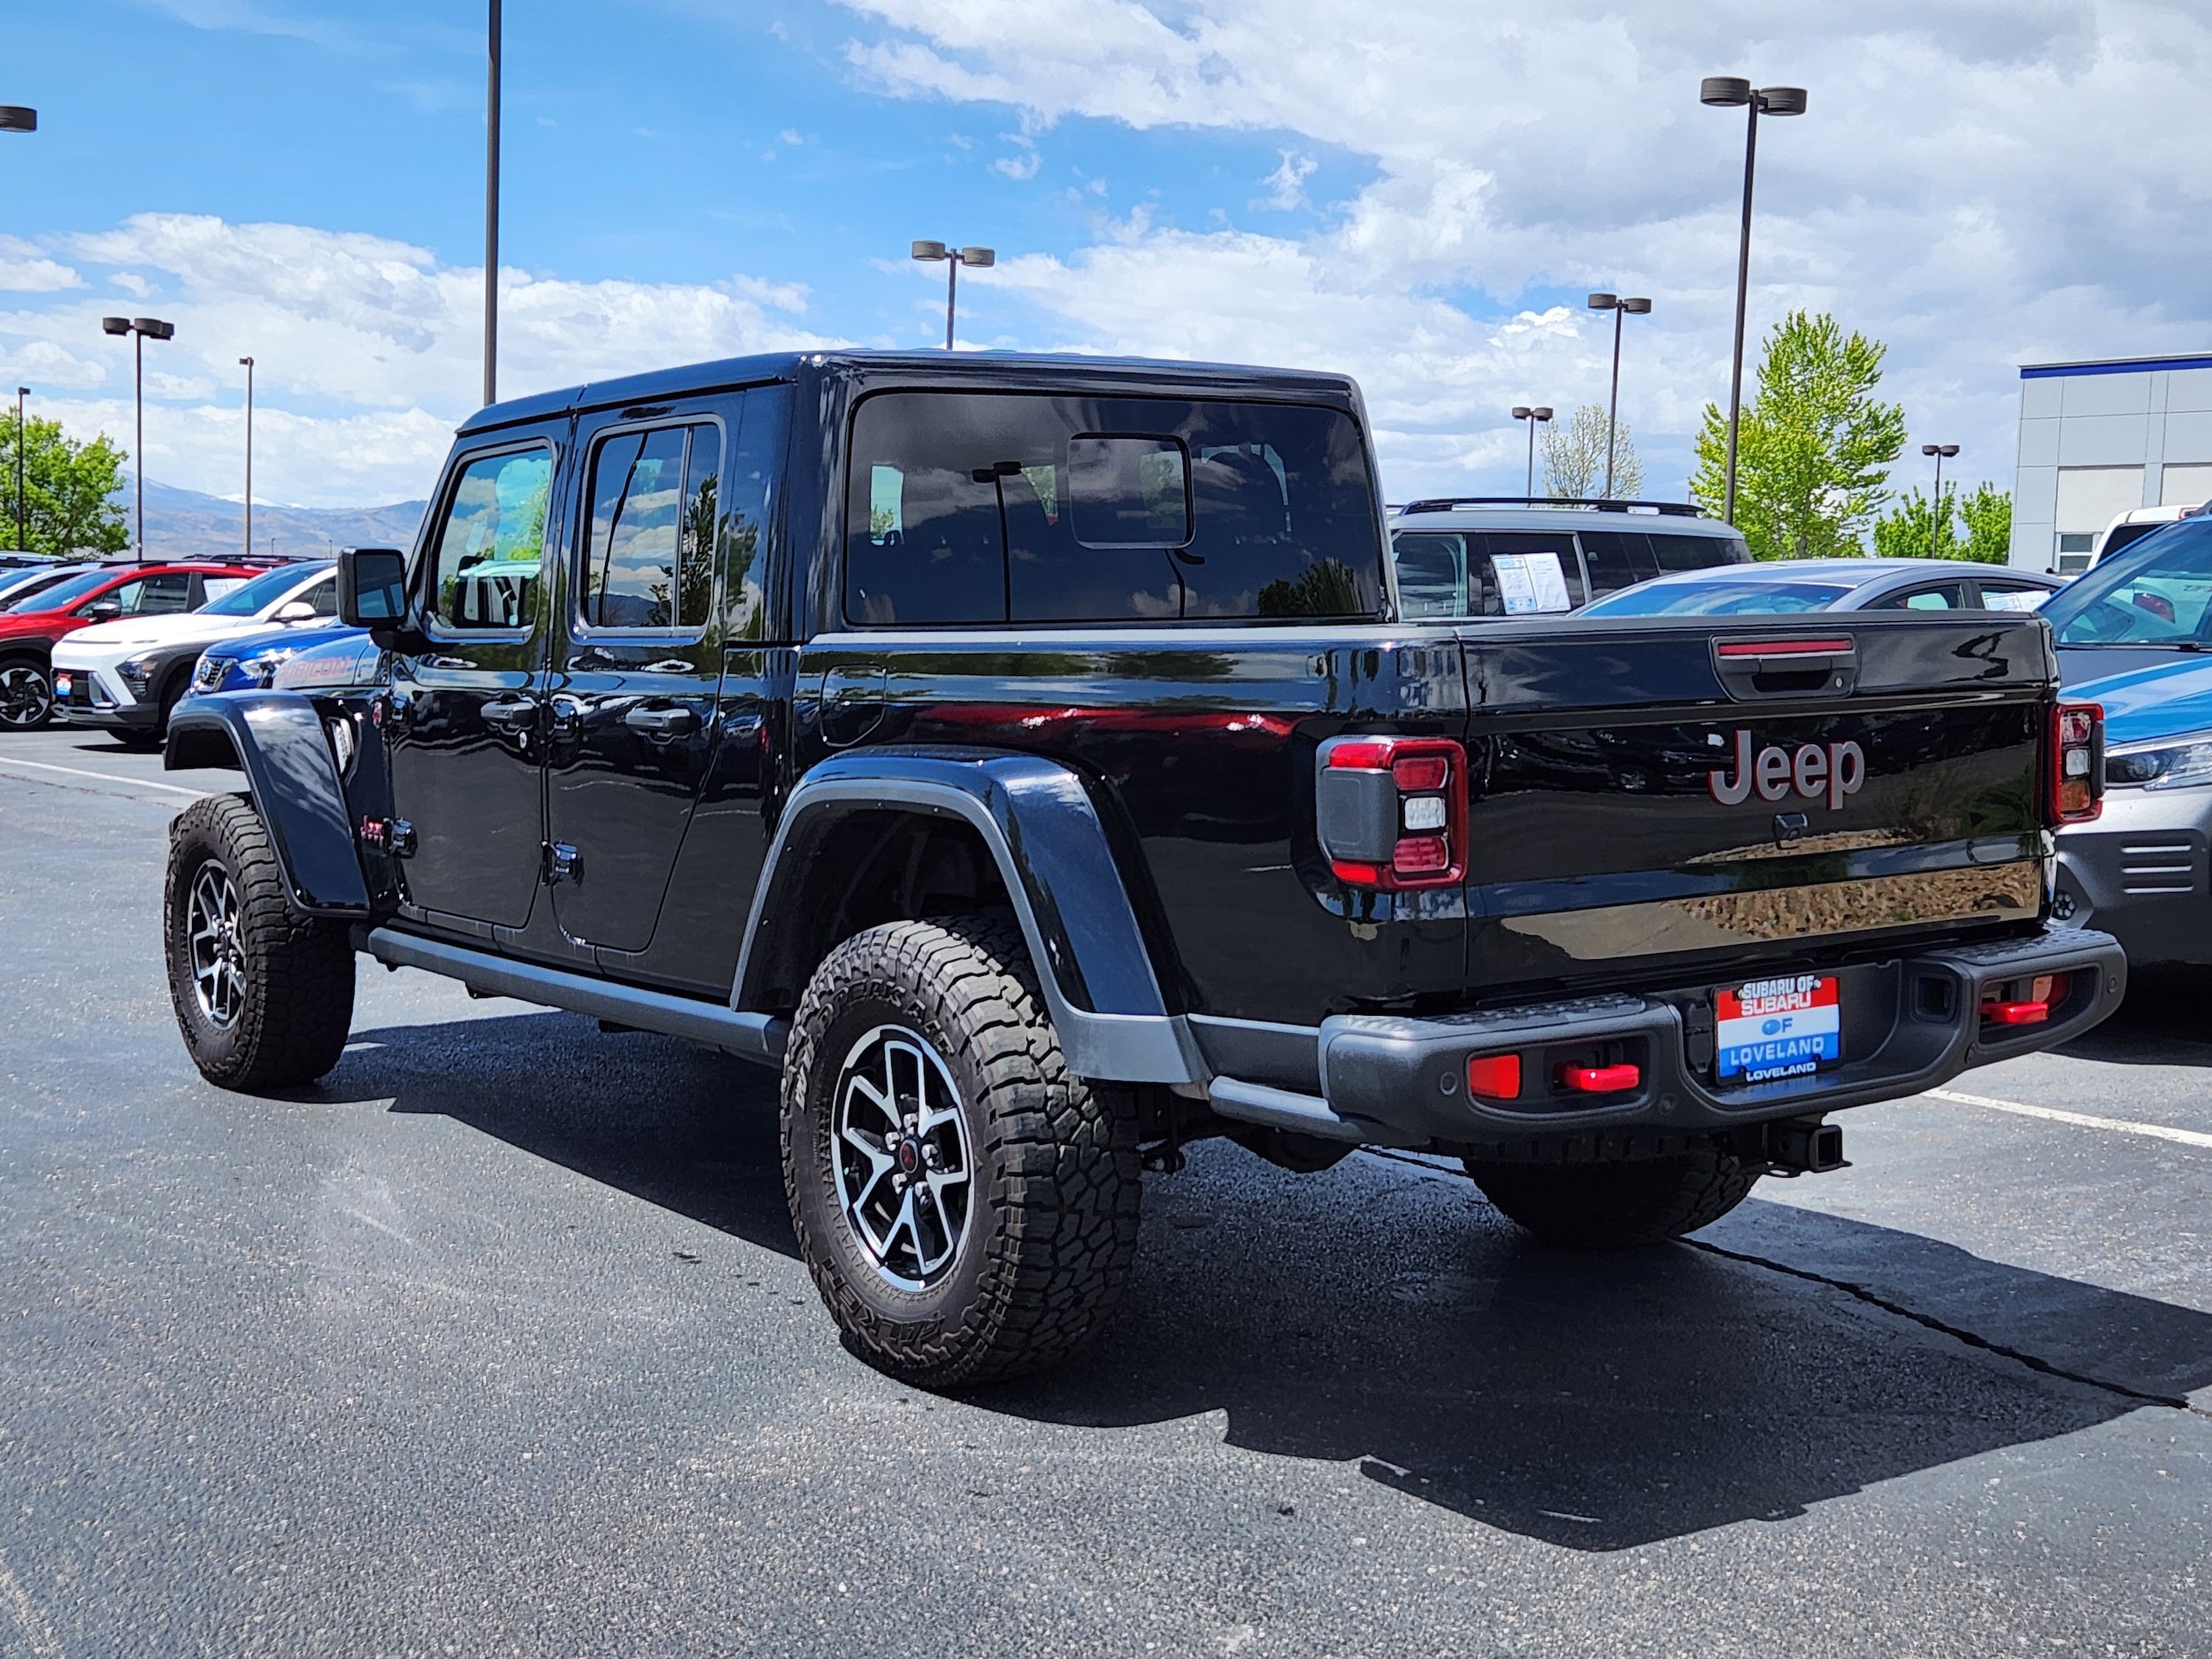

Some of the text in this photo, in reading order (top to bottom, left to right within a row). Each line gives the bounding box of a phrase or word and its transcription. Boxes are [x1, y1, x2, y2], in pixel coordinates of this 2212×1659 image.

[279, 656, 351, 682] RUBICON
[1709, 729, 1865, 811] Jeep
[1742, 975, 1815, 1000] SUBARU OF
[1741, 992, 1812, 1017] SUBARU
[1762, 1018, 1793, 1036] OF
[1731, 1037, 1825, 1066] LOVELAND
[1746, 1062, 1817, 1082] LOVELAND
